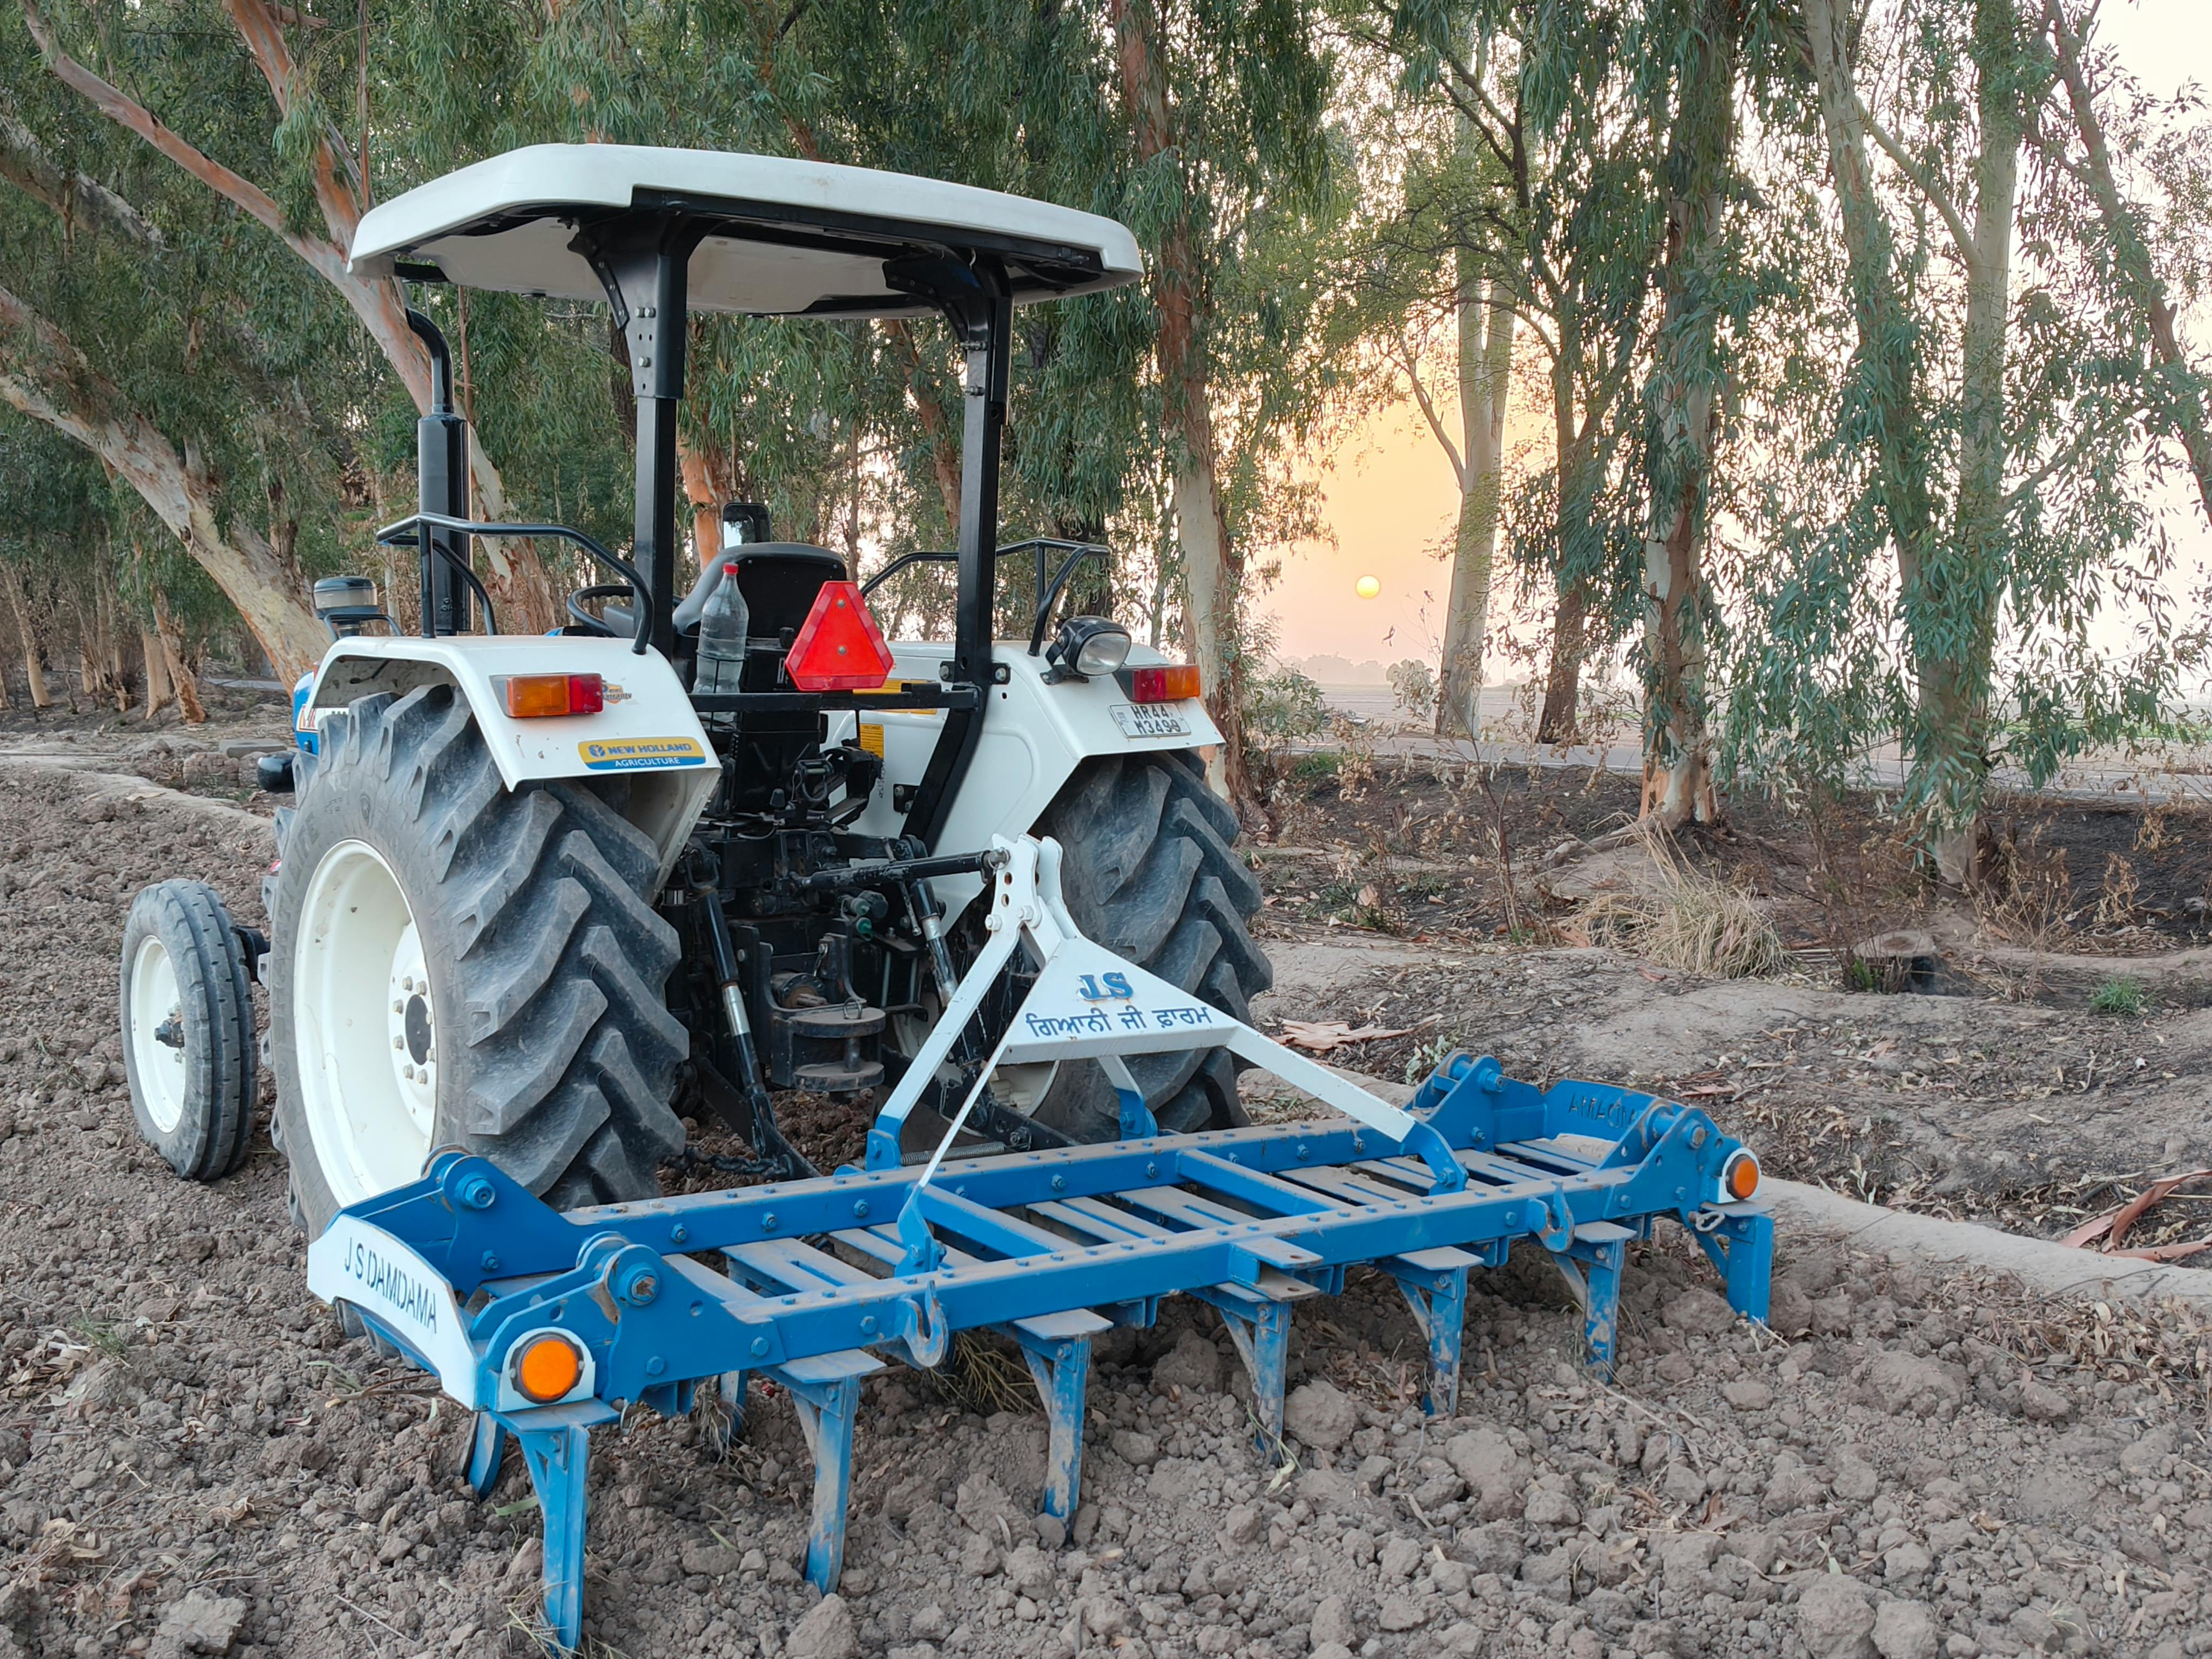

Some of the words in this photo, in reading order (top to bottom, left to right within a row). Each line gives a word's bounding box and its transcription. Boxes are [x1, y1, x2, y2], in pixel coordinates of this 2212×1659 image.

[1130, 704, 1169, 720] HR44
[608, 746, 636, 755] NEW
[639, 743, 692, 753] HOLLAND
[615, 757, 680, 767] AGRICULTURE
[1078, 972, 1134, 1001] JS
[1026, 1008, 1112, 1037] ਗਿਆਨੀ
[1117, 1005, 1147, 1030] ਜੀ
